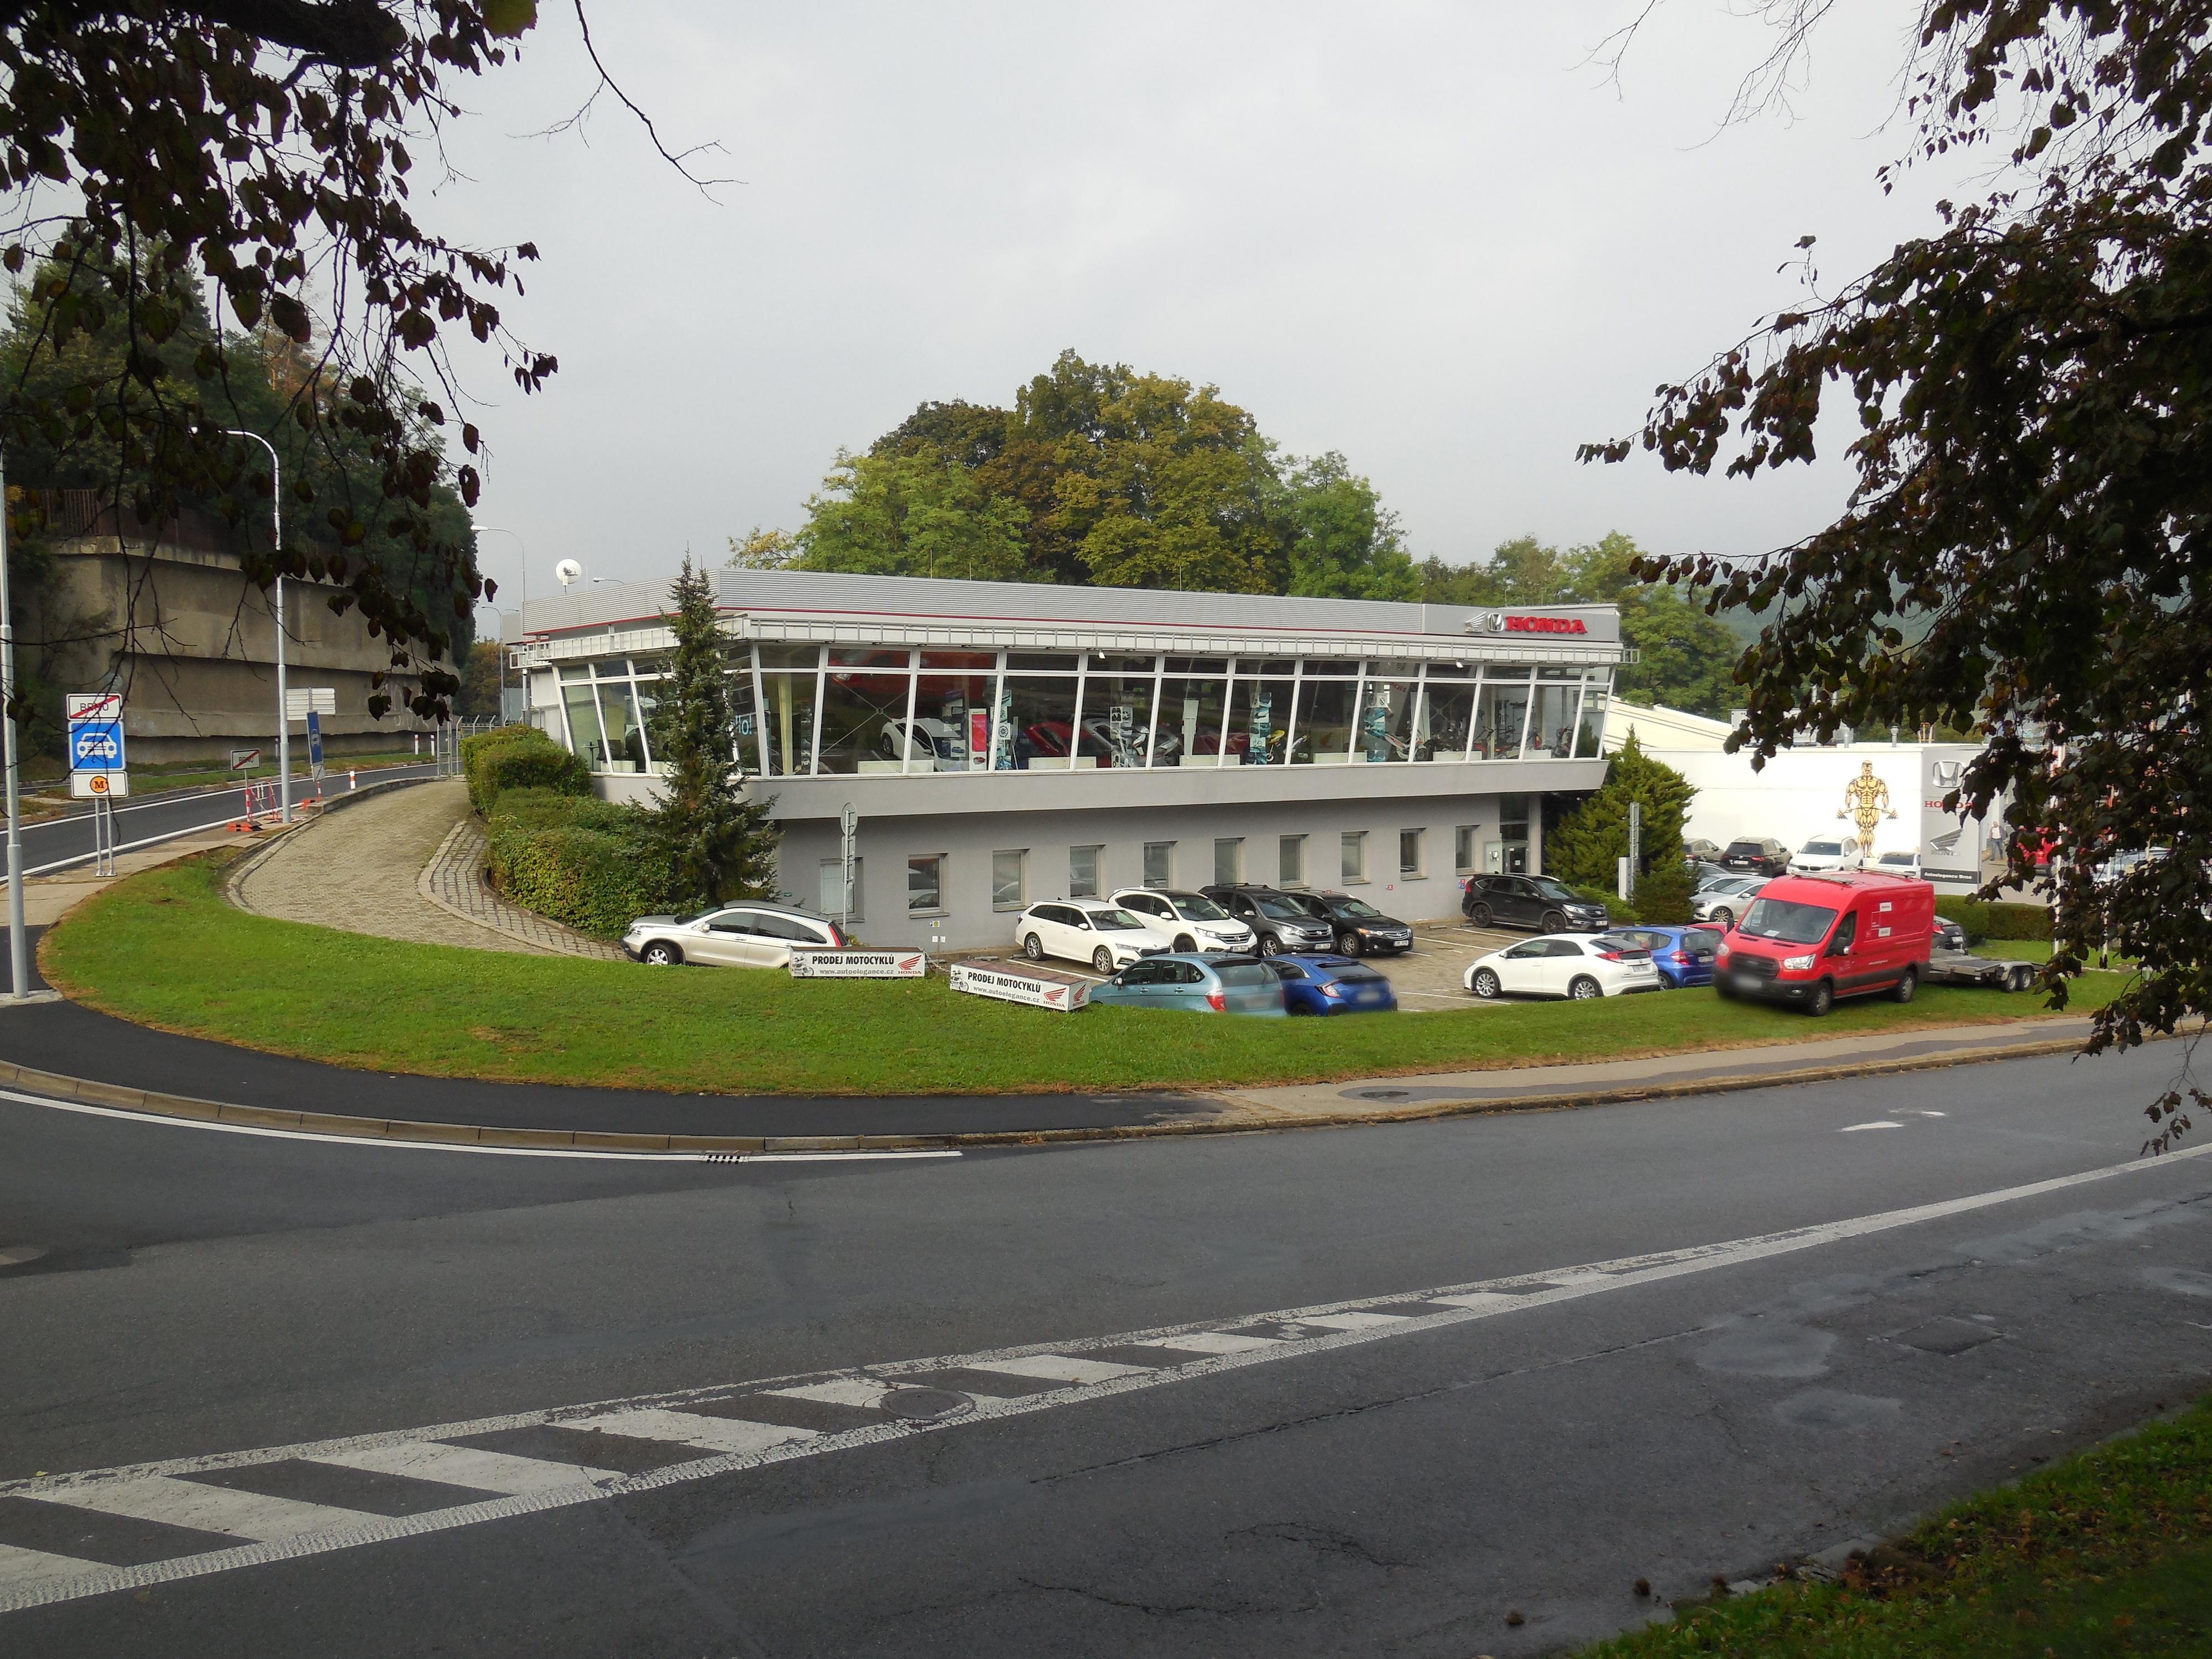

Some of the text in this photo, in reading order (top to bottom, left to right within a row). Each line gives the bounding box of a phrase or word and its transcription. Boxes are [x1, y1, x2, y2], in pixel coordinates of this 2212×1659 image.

[1505, 615, 1588, 634] HONDA
[812, 954, 894, 965] PRODEJ MOTOCYKLŮ
[968, 972, 1041, 993] PRODEJ MOTOCYKLŮ
[973, 986, 1040, 1003] www.autoelegance.cz
